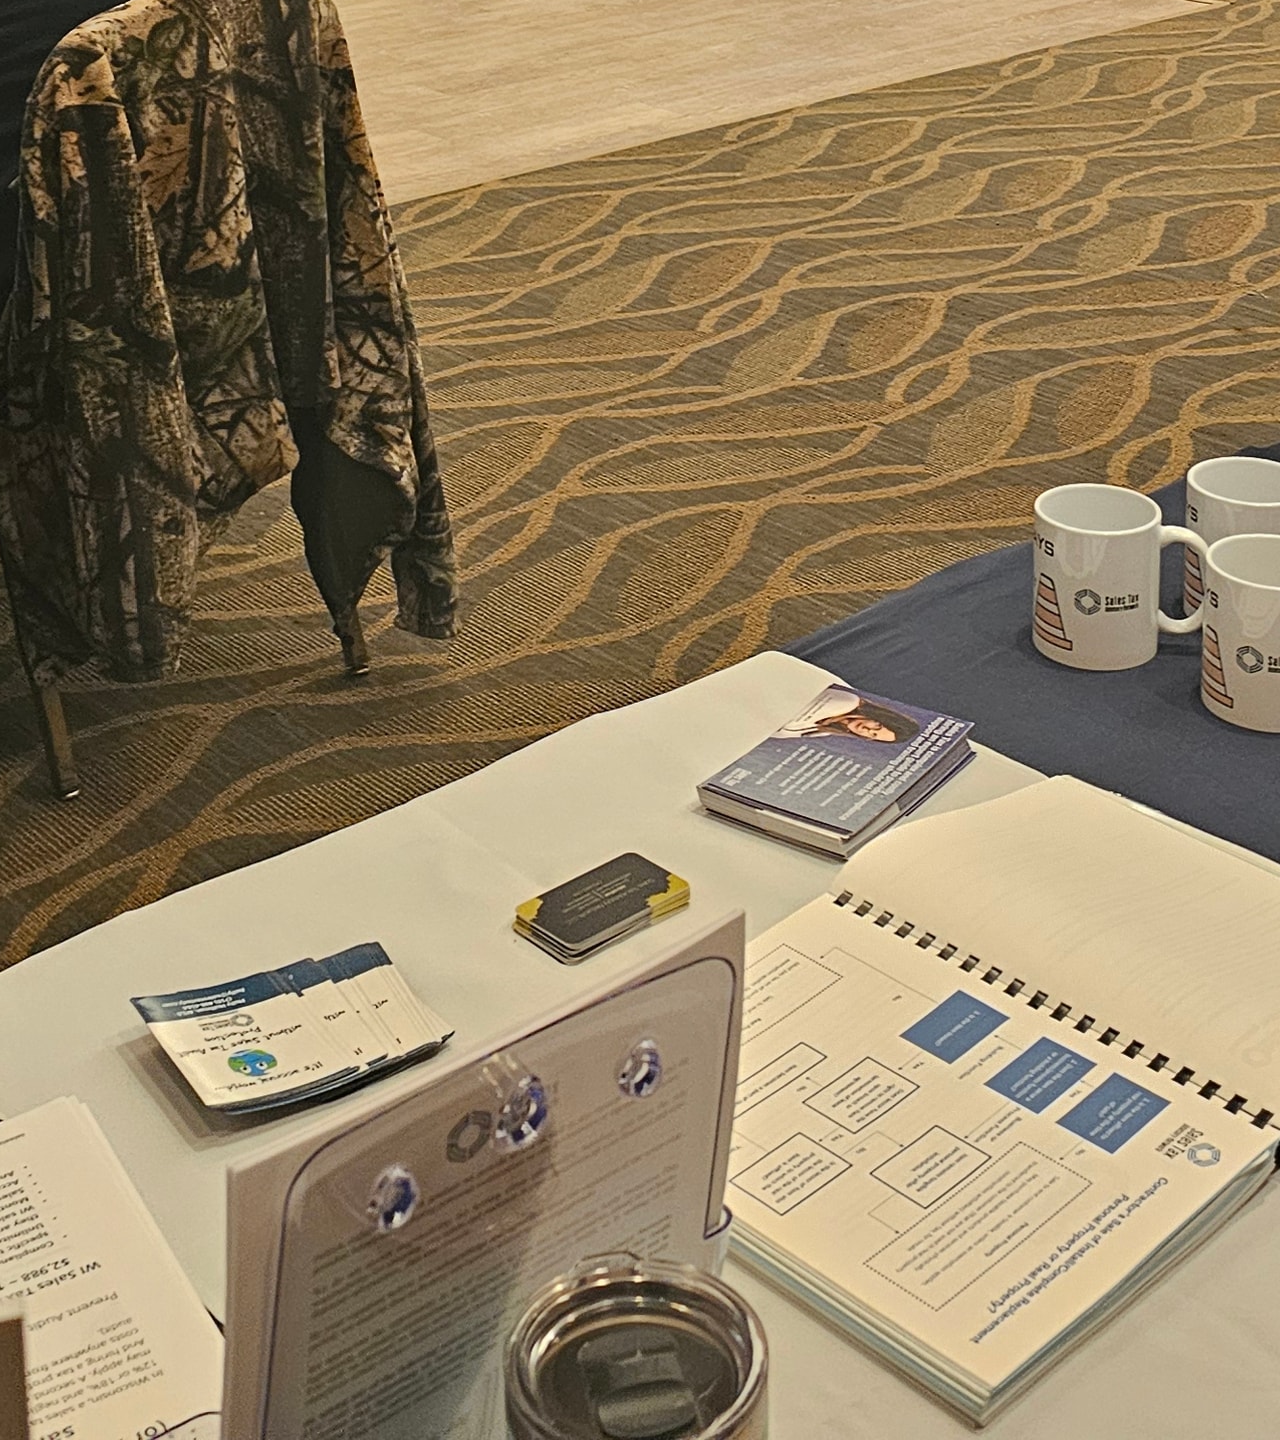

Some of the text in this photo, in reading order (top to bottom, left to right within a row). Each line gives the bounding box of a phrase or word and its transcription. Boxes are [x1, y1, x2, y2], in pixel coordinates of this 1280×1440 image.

[1105, 594, 1139, 606] Sales Tax
[1163, 1127, 1204, 1159] Sales Tax
[19, 1204, 34, 1214] WI
[969, 1176, 1168, 1344] Contractor's Sale of Install/Complete Replacement
[987, 1193, 1130, 1314] Personal Property or Real Property?
[20, 1257, 70, 1281] $2,988
[79, 1260, 101, 1274] WI
[36, 1270, 76, 1289] Sales
[67, 1291, 118, 1316] Prevent
